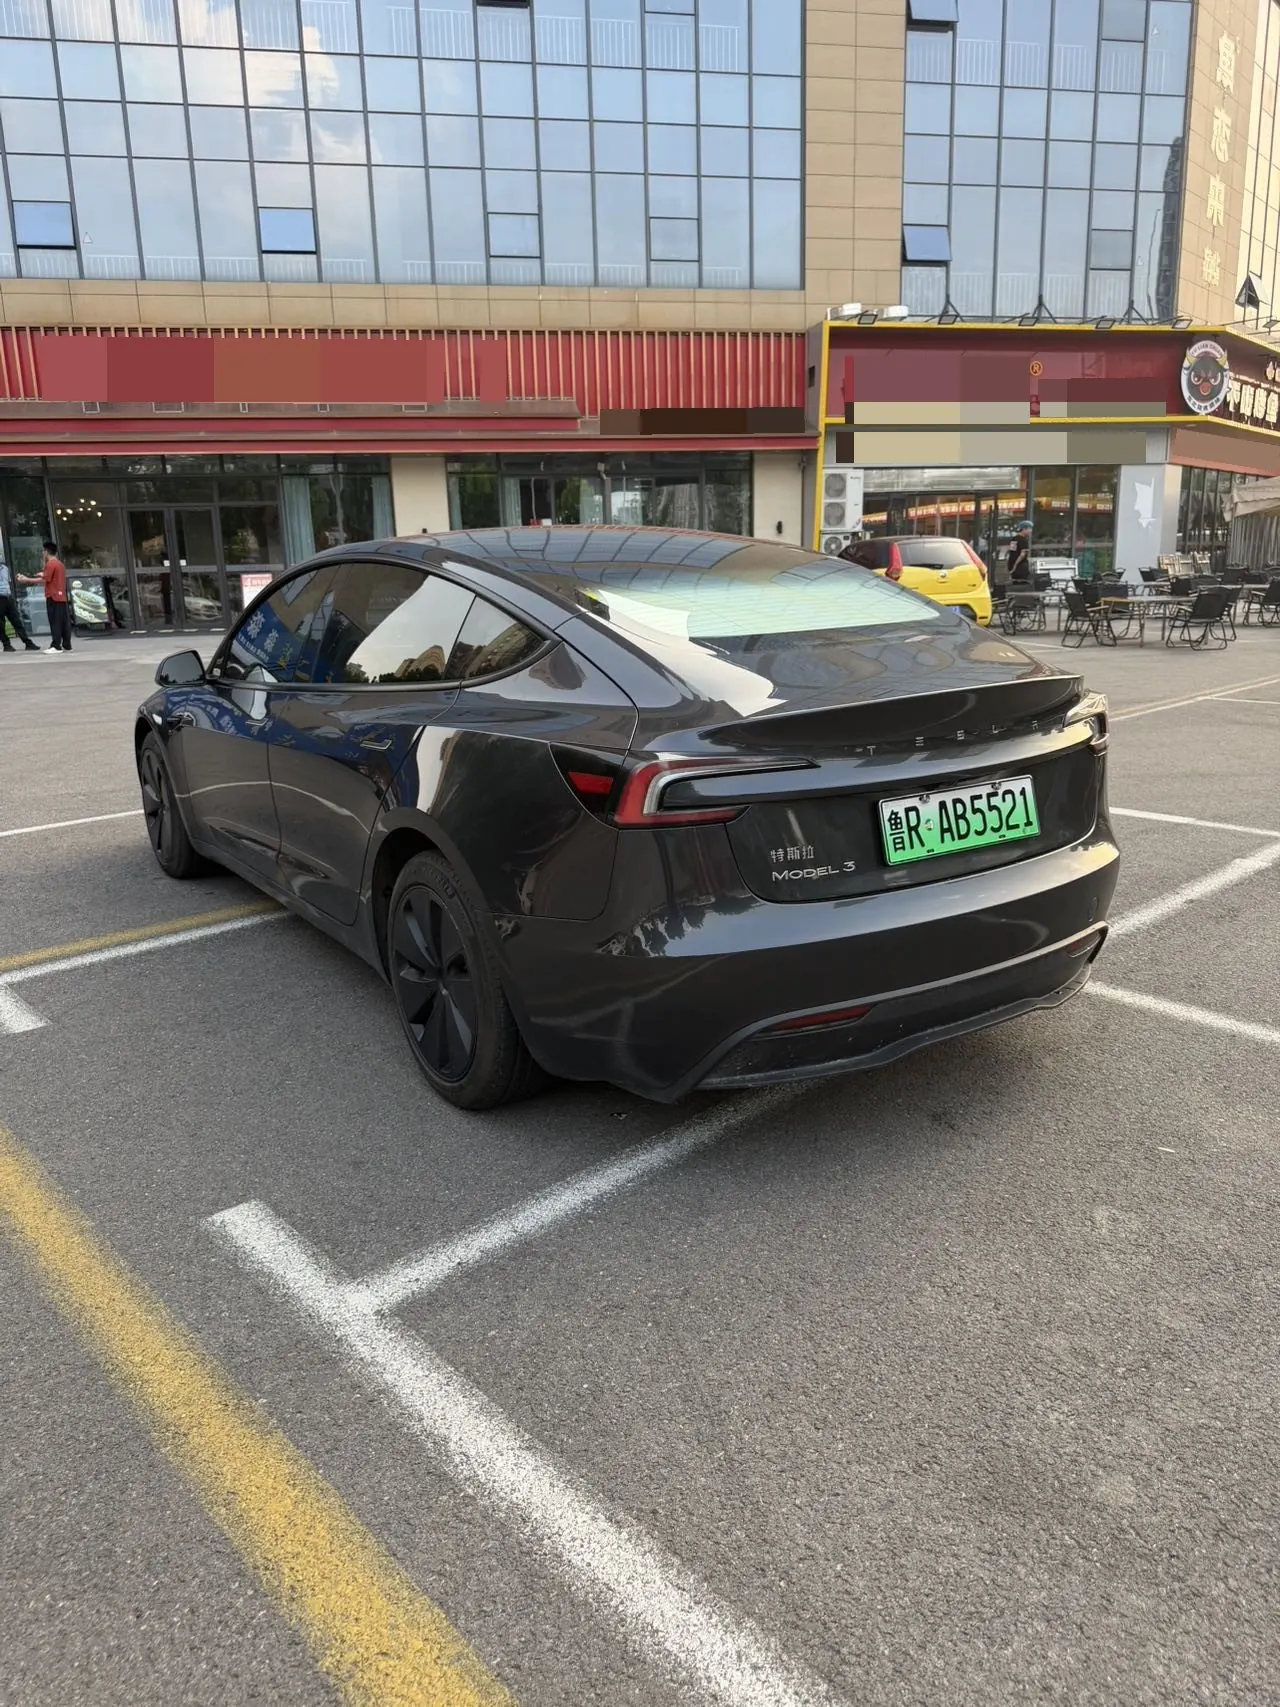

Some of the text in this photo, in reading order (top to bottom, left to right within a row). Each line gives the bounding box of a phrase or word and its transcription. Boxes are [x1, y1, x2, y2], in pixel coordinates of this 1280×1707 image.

[770, 845, 815, 863] 特斯拉
[772, 860, 857, 881] MODEL 3
